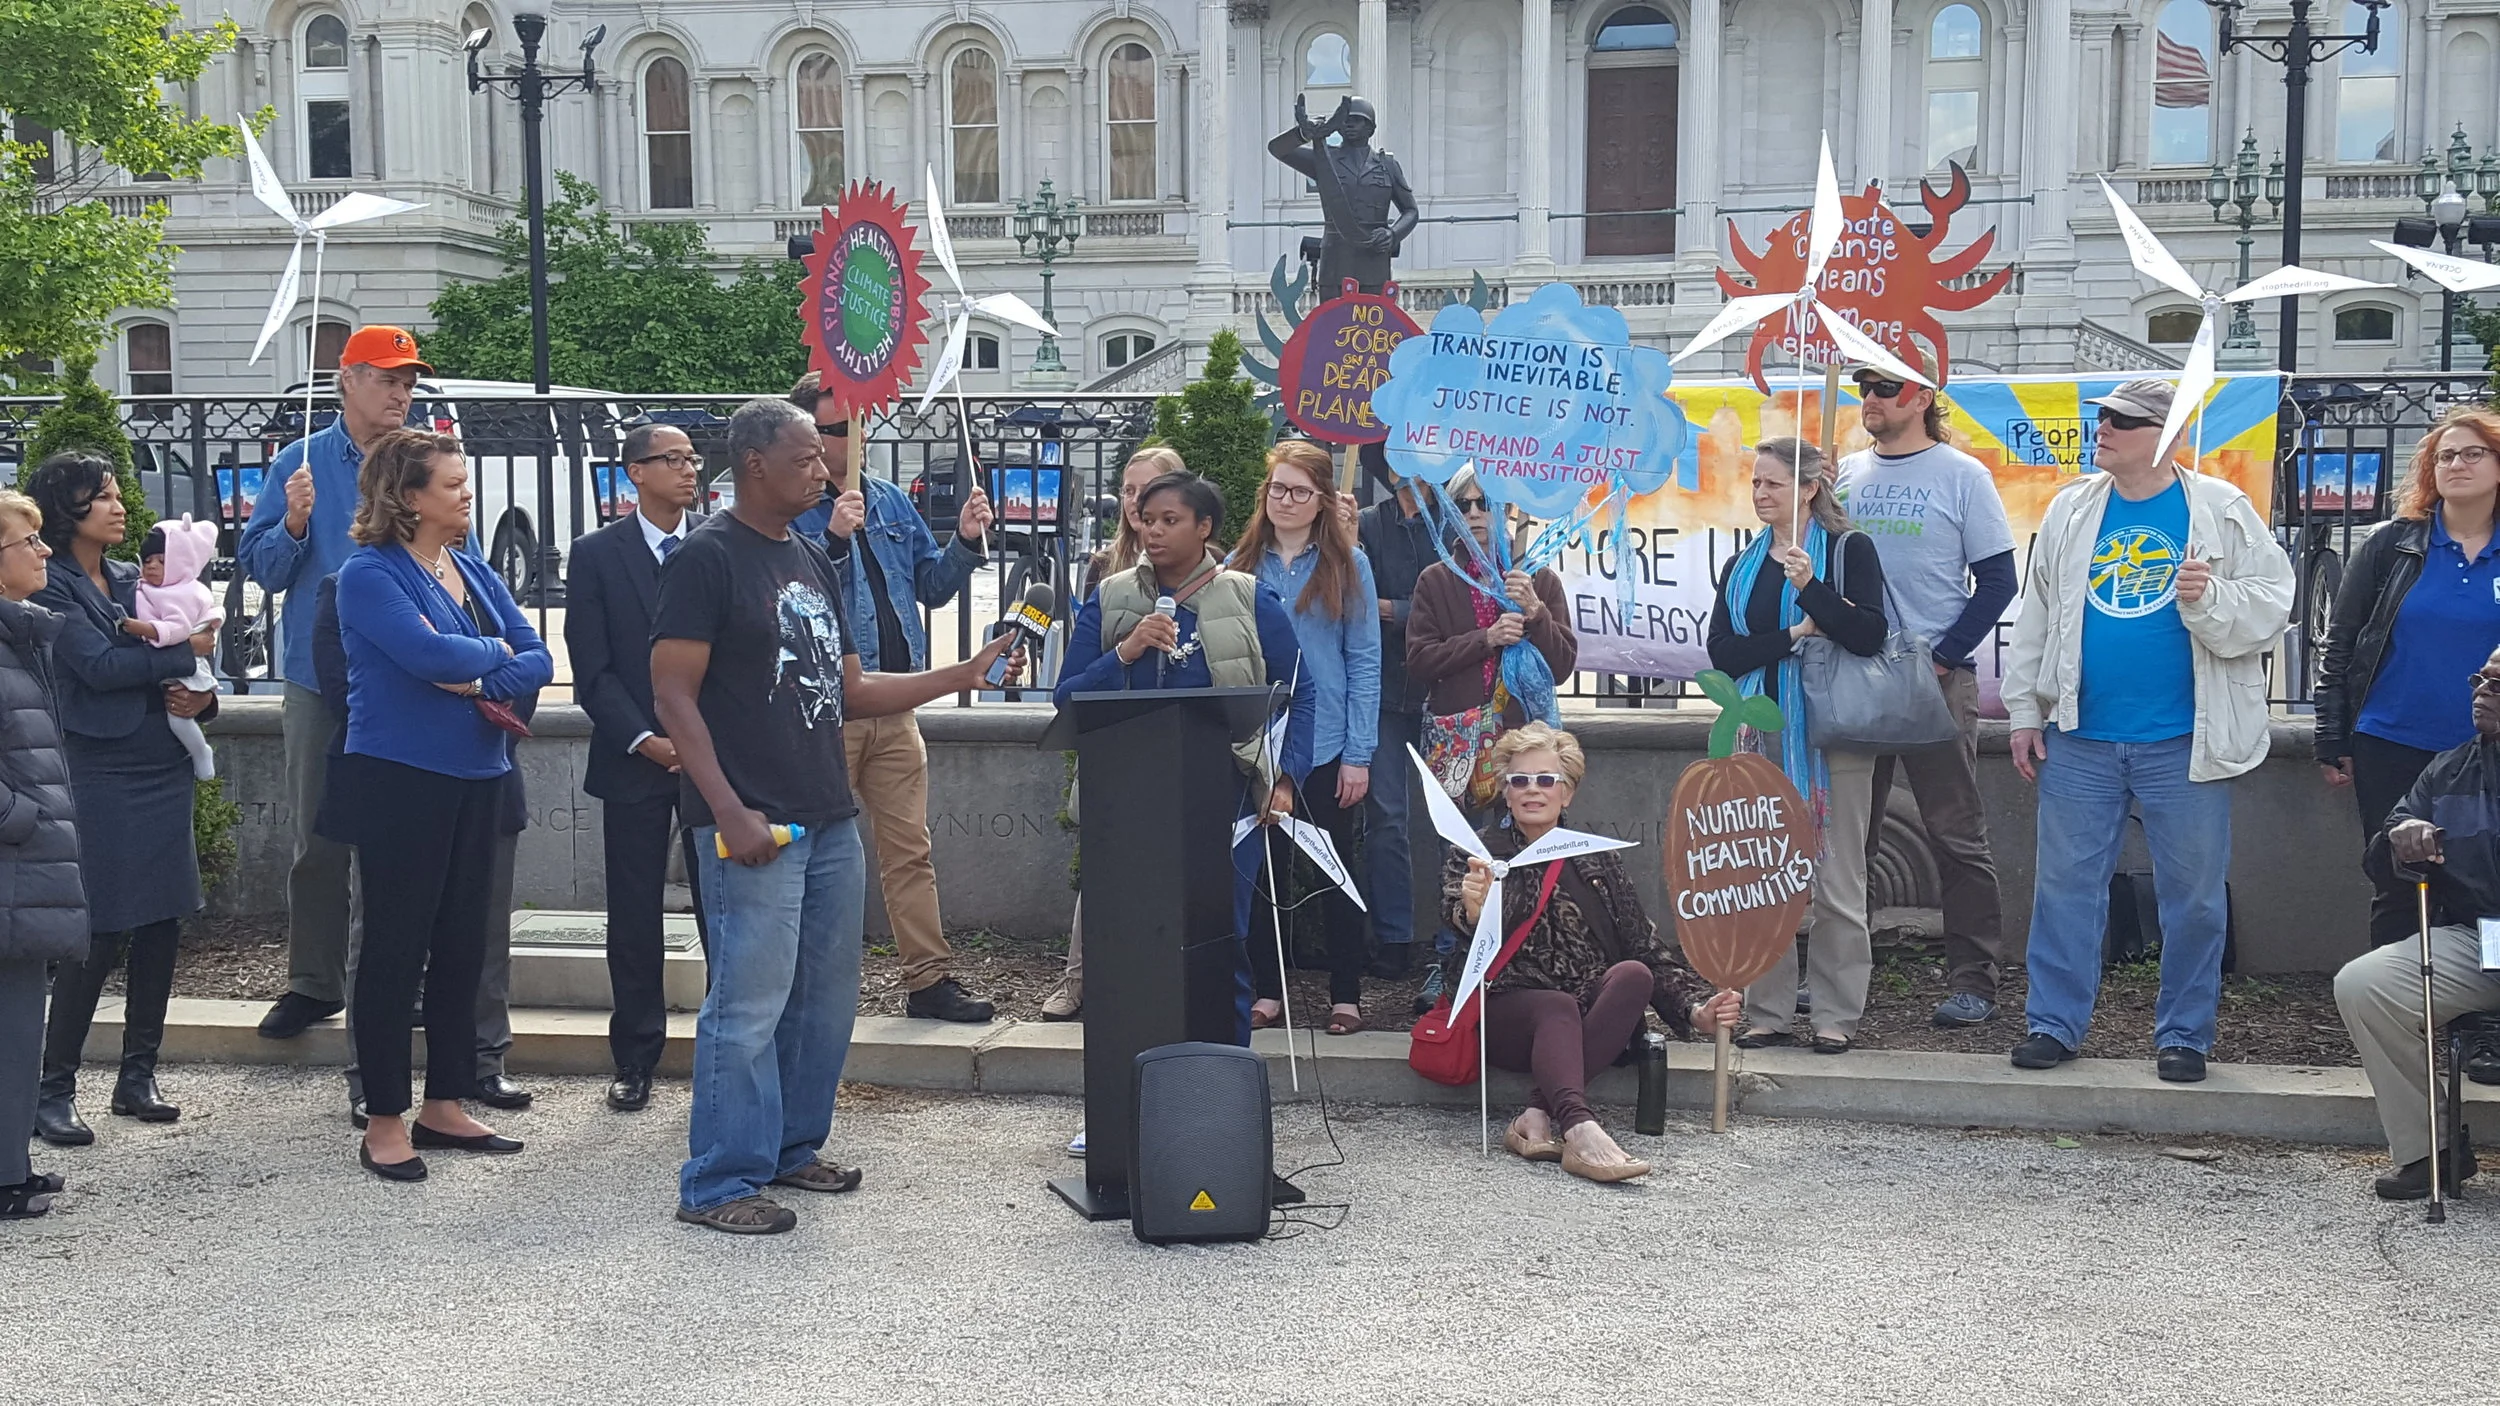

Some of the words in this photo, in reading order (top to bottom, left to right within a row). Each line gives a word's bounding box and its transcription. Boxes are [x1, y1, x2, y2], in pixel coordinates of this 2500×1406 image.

[850, 227, 899, 272] HEALTHY
[1795, 235, 1900, 265] Cange
[2426, 261, 2462, 273] OCEANA
[824, 240, 849, 332] PLANET
[847, 264, 890, 307] CLIMATE
[2261, 280, 2329, 290] stopthedrill.org
[838, 284, 887, 331] JUSTICE
[889, 274, 902, 333] JOBS
[1352, 304, 1384, 326] NO
[836, 332, 894, 375] HEALTHY
[1335, 325, 1403, 355] JOBS
[1430, 332, 1567, 366] TRANSITION
[1581, 347, 1604, 369] IS
[1323, 362, 1391, 392] DEAD
[1343, 353, 1363, 366] ON
[1367, 355, 1378, 368] A
[1486, 363, 1627, 396] INEVITABLE.
[1297, 389, 1386, 430] PLANE
[1433, 387, 1533, 417] JUSTICE
[1548, 399, 1571, 419] IS
[1584, 403, 1635, 427] NOT.
[1406, 422, 1441, 446] WE
[1449, 428, 1540, 457] DEMAND
[1551, 441, 1566, 461] A
[1576, 444, 1642, 470] JUST
[2012, 421, 2098, 449] Peopl
[1479, 457, 1609, 485] TRANSITION
[1856, 501, 1925, 519] WATER
[1861, 484, 1932, 501] CLEAN
[1030, 605, 1051, 629] REAL
[1575, 593, 1708, 647] ENERGY
[1685, 795, 1785, 840] NURTURE
[1298, 829, 1337, 871] stopthedrill.org
[1536, 840, 1590, 855] stopthedrill.org
[1686, 833, 1789, 880] HEALTHY
[1472, 939, 1486, 974] OCEANA
